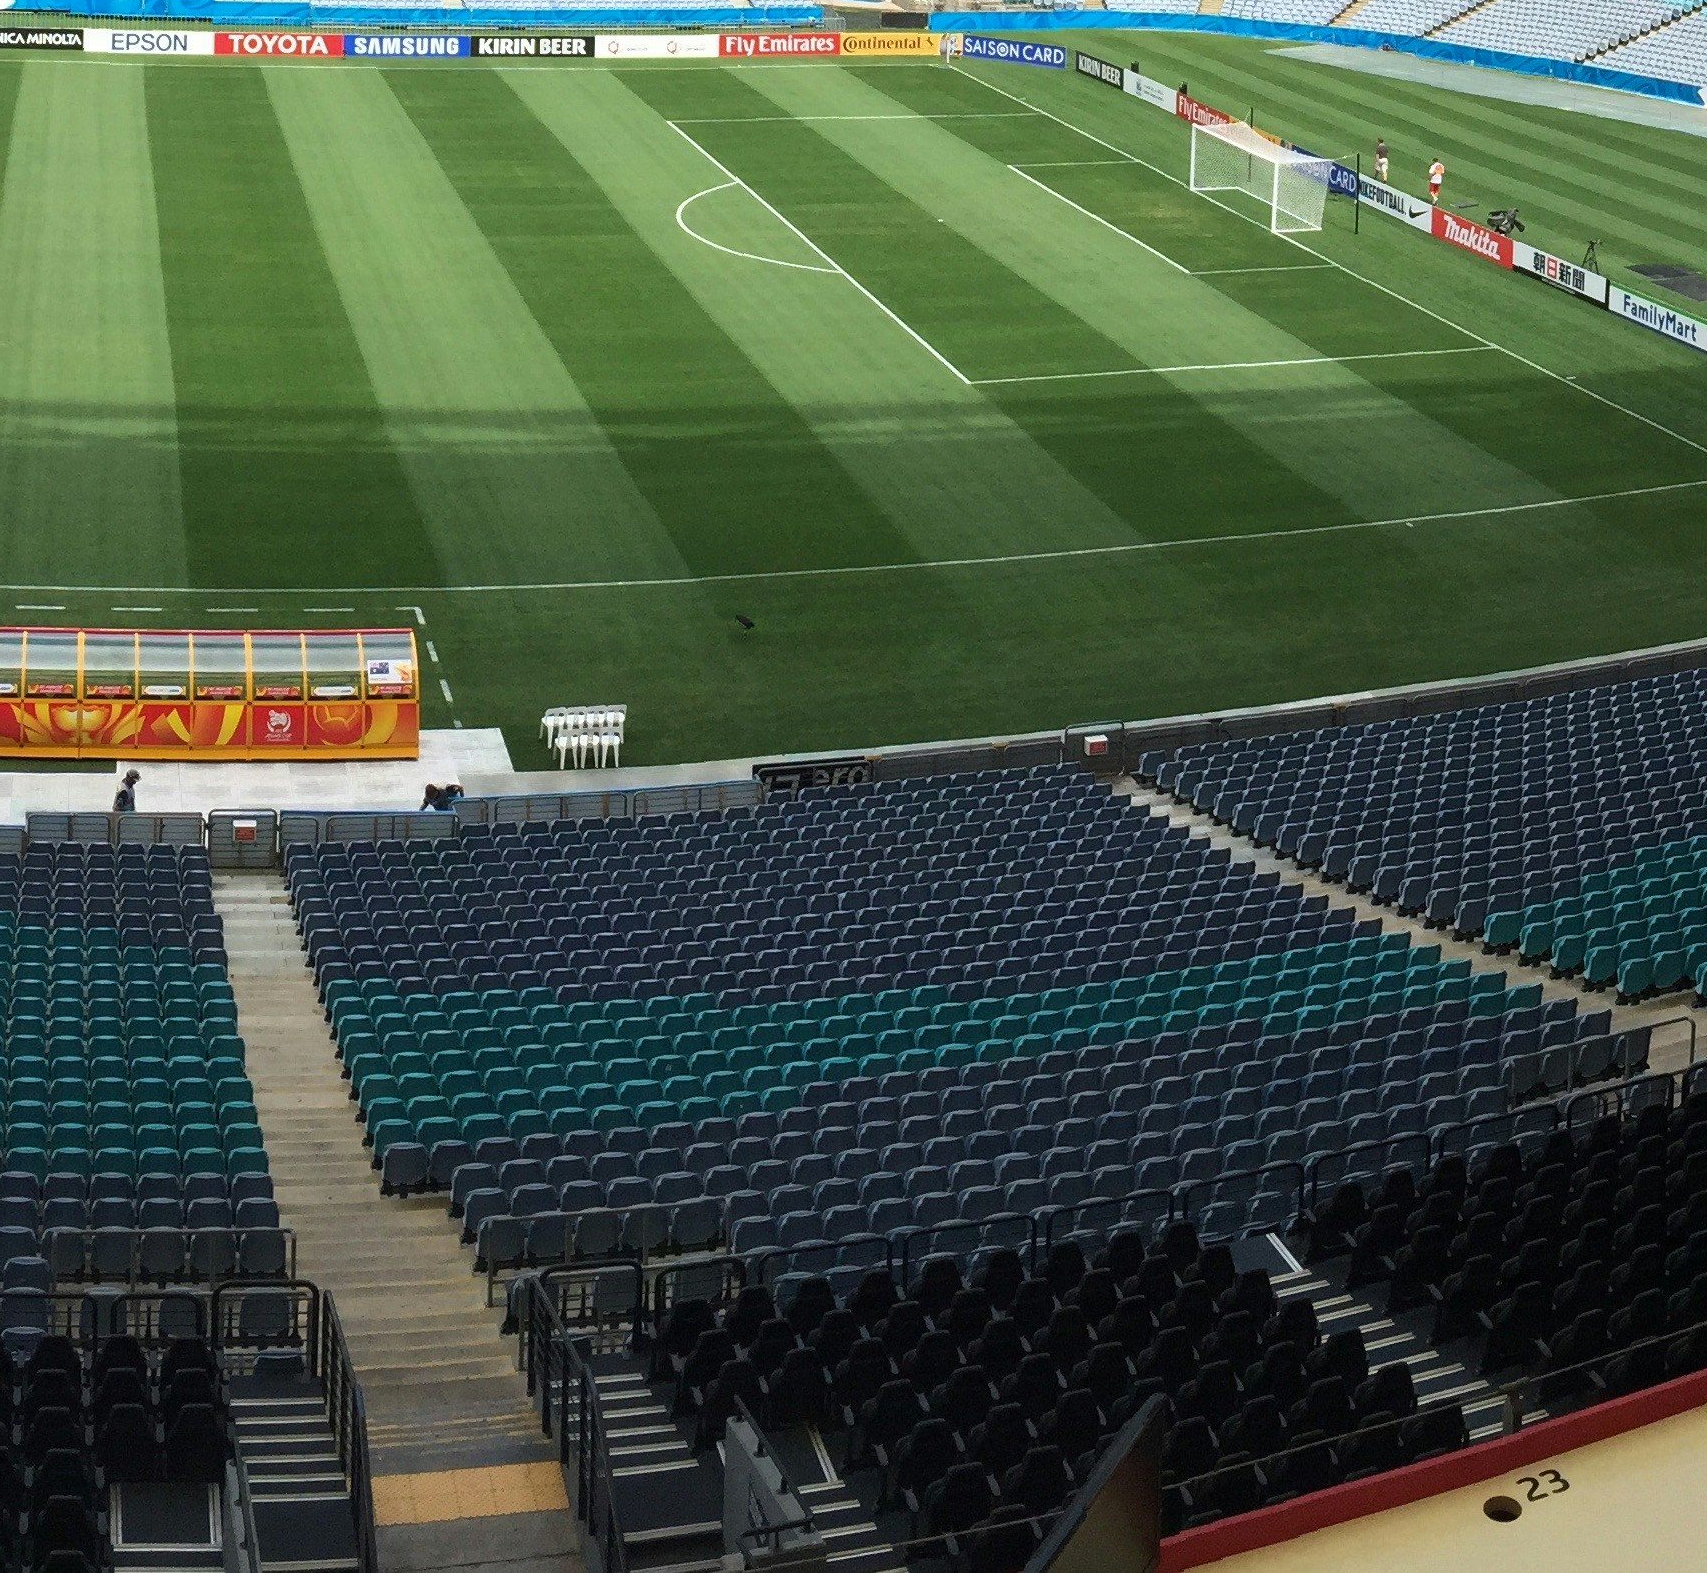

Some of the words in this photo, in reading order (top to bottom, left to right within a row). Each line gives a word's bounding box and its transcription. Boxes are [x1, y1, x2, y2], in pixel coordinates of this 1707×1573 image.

[26, 32, 81, 45] MINOLTA
[112, 33, 187, 51] EPSON
[228, 35, 329, 54] TOYOTA
[354, 37, 459, 55] SAMSUNG
[479, 38, 537, 55] KIRIN
[539, 38, 586, 55] BEER
[725, 36, 754, 56] Fly
[759, 35, 835, 53] Emirates
[843, 36, 921, 52] Continental
[964, 37, 1019, 57] SAISON
[1022, 45, 1065, 65] CARD
[1079, 55, 1100, 78] KIRIN
[1101, 63, 1121, 86] BEER
[1178, 95, 1193, 120] Fly
[1330, 166, 1356, 192] CARD
[1533, 251, 1585, 292] 朝日新聞
[1623, 293, 1697, 342] FamilyMart
[1516, 1469, 1570, 1502] 23
